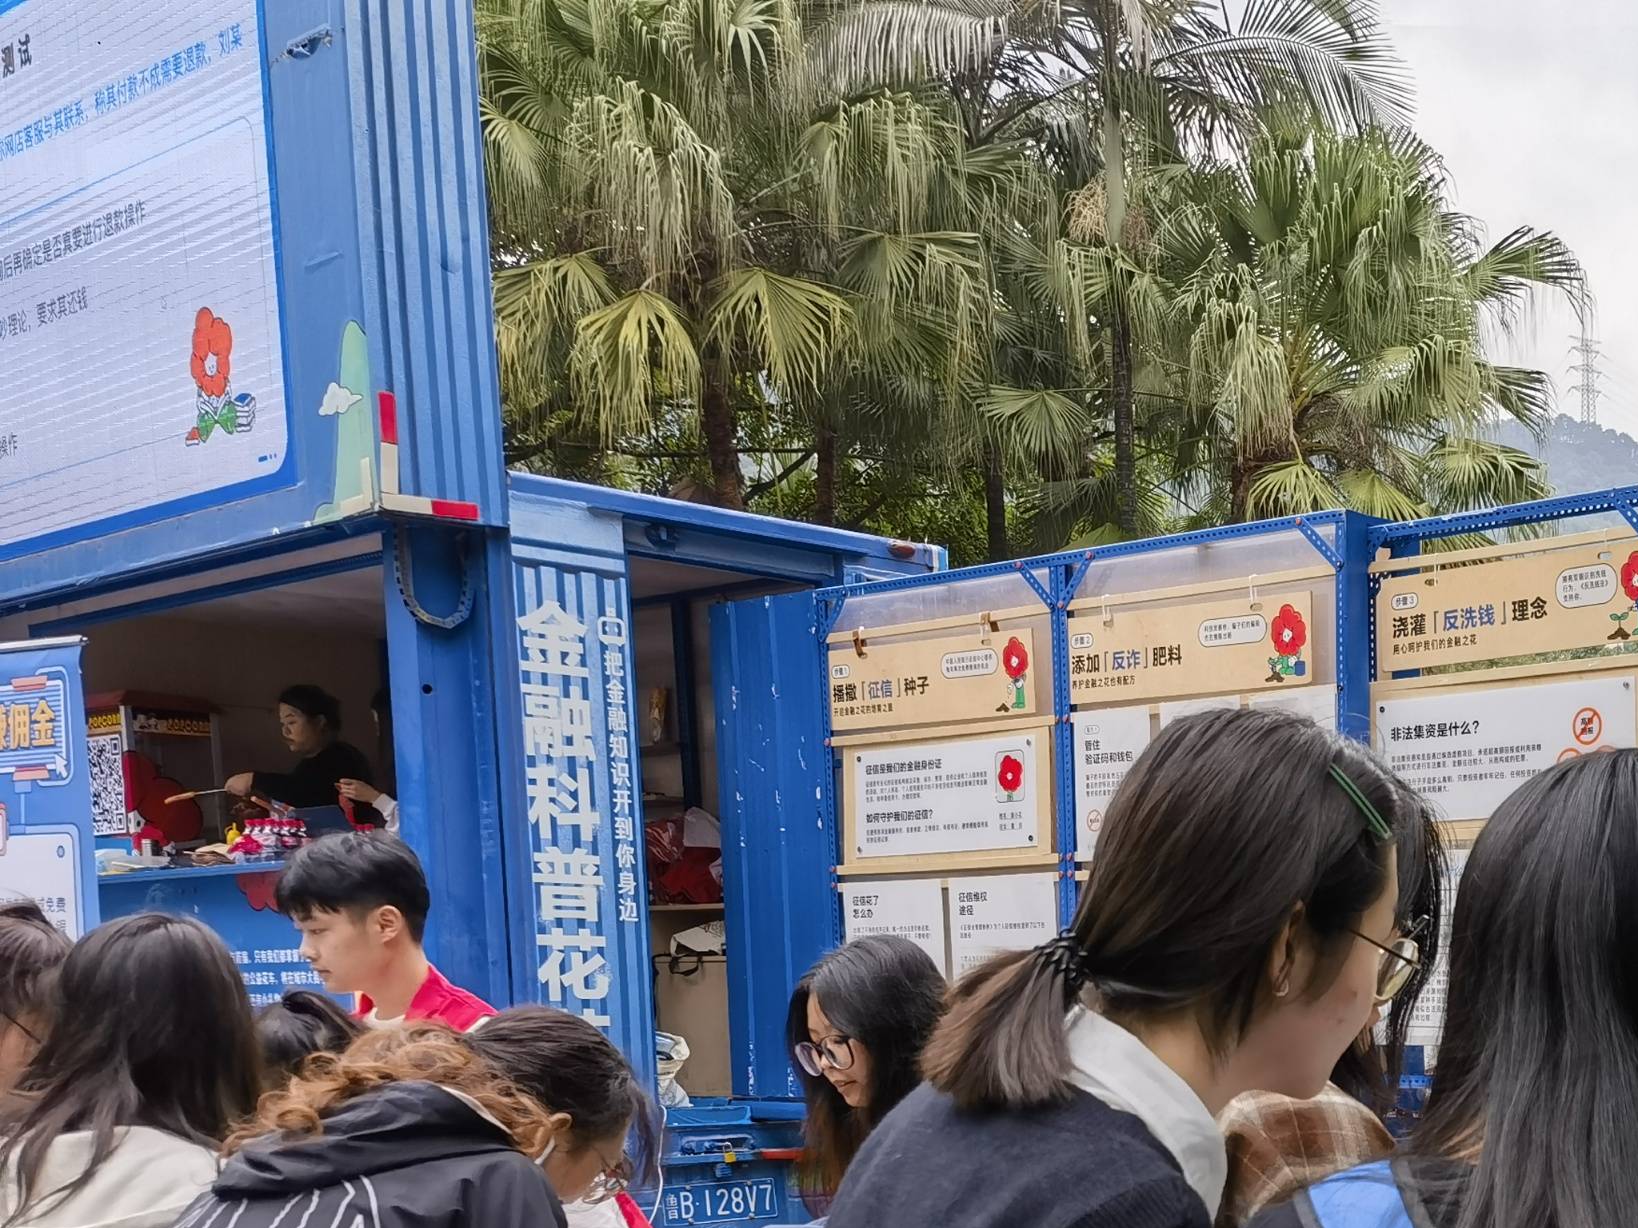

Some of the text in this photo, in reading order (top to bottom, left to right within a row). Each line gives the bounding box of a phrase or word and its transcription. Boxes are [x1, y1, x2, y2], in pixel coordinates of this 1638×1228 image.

[2, 33, 32, 78] 测试
[1392, 597, 1548, 639] 浇灌「反洗钱」理念
[1072, 643, 1183, 675] 添加「反诈」肥料
[1390, 720, 1480, 742] 非法集资是什么？
[603, 651, 640, 923] 把金融知识开到你身边
[516, 601, 613, 1030] 金融科普花
